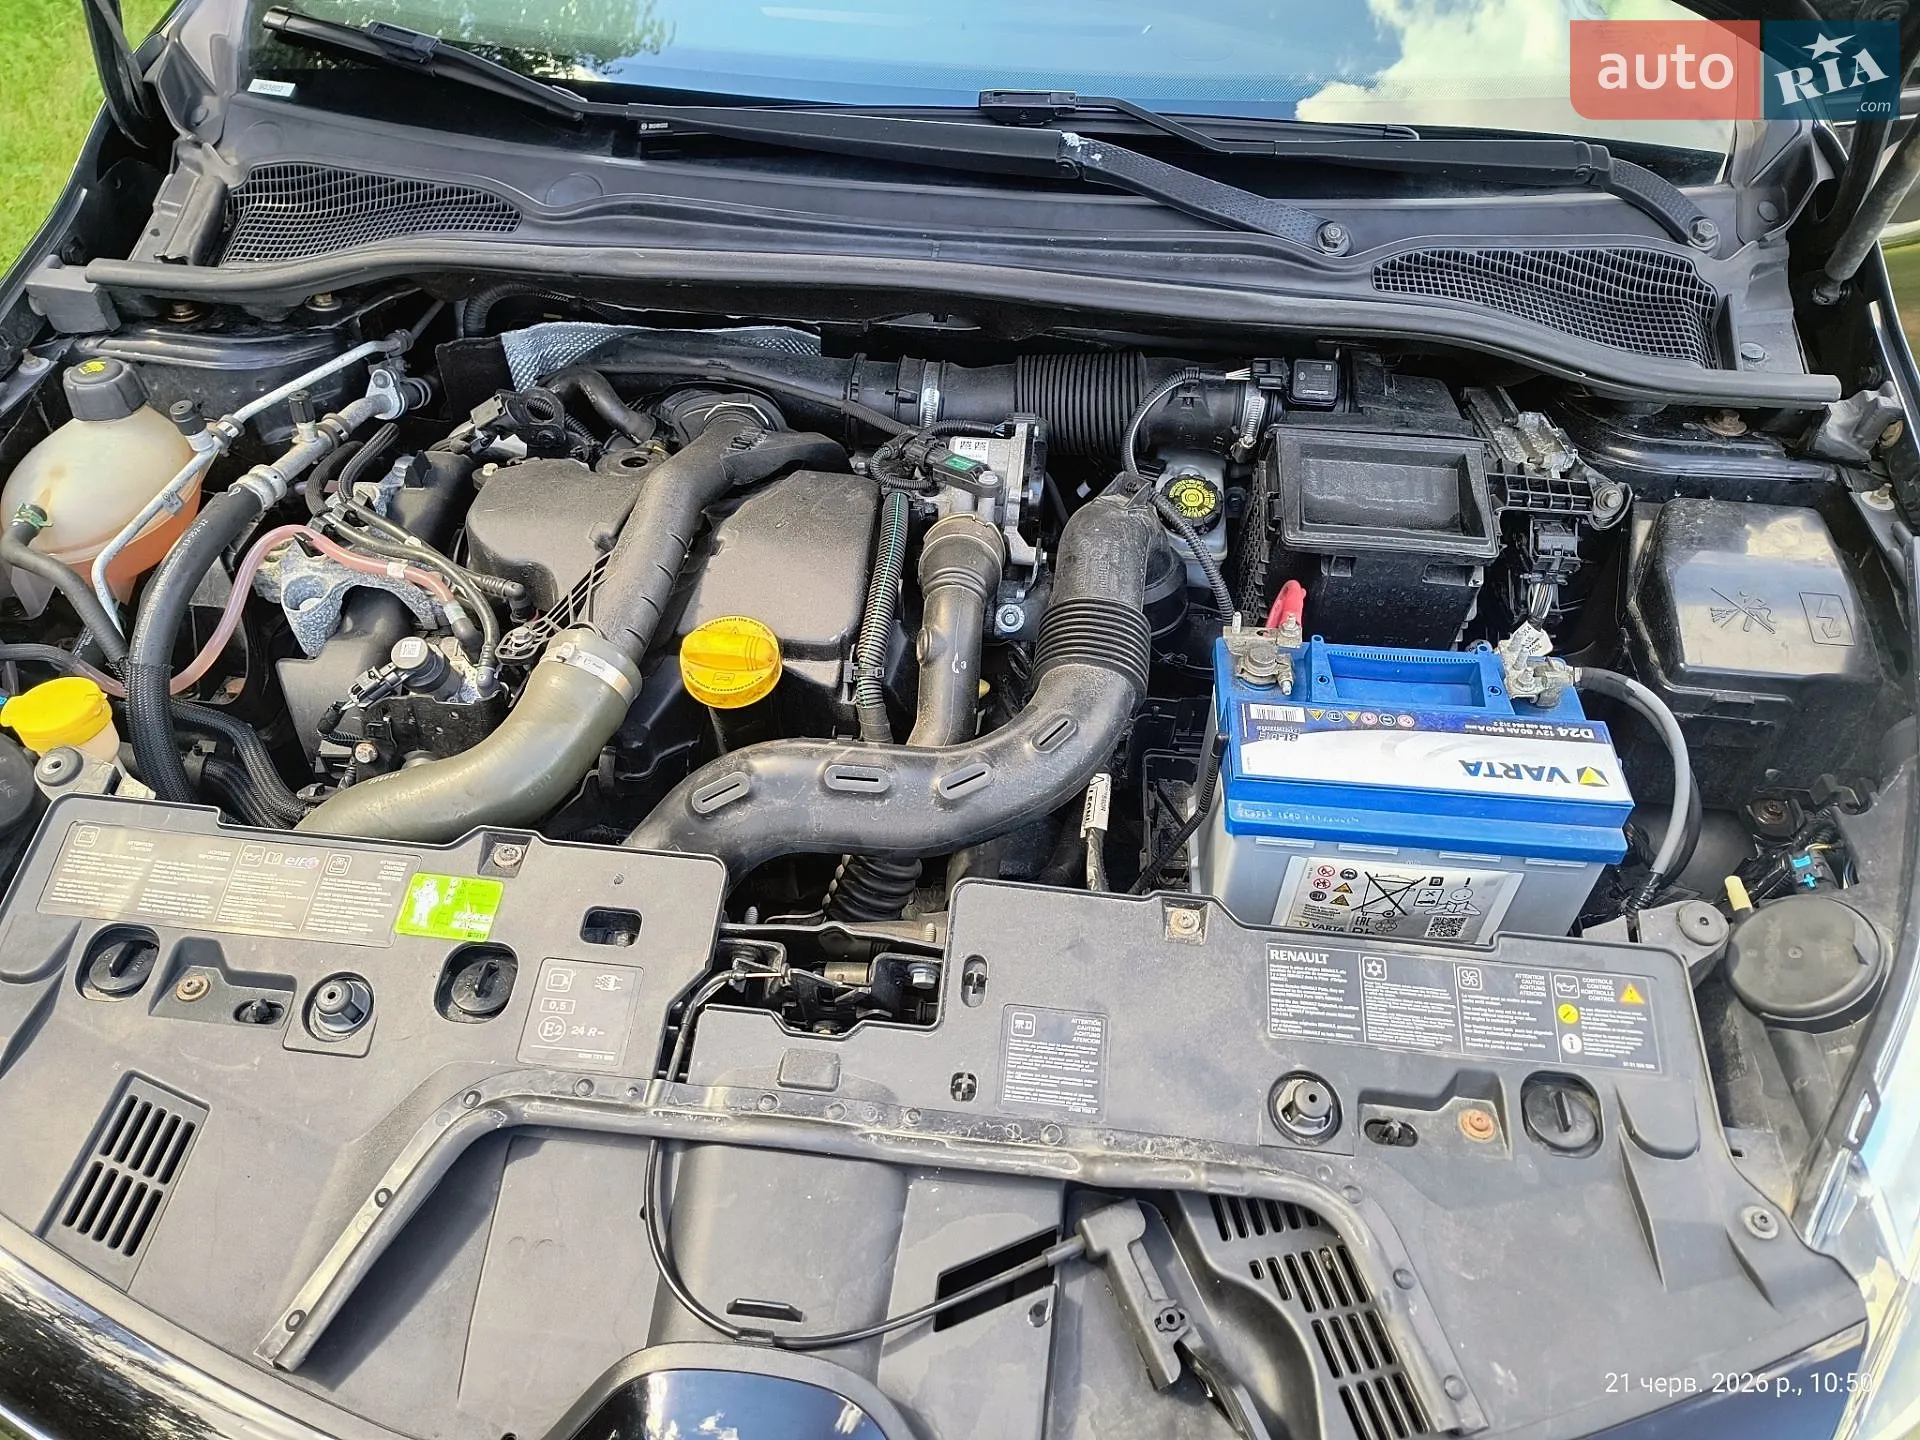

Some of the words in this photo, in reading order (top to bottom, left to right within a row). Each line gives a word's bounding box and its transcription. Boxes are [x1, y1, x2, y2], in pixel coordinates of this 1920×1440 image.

[1536, 729, 1555, 737] 12V
[1557, 727, 1595, 740] D24
[1458, 759, 1571, 784] VARTA
[1311, 923, 1346, 932] VARTA
[1270, 949, 1329, 965] RENAULT
[1514, 973, 1545, 981] ATTENTION
[549, 1001, 567, 1012] 0,5
[543, 1022, 563, 1037] E2
[571, 1025, 585, 1036] 24
